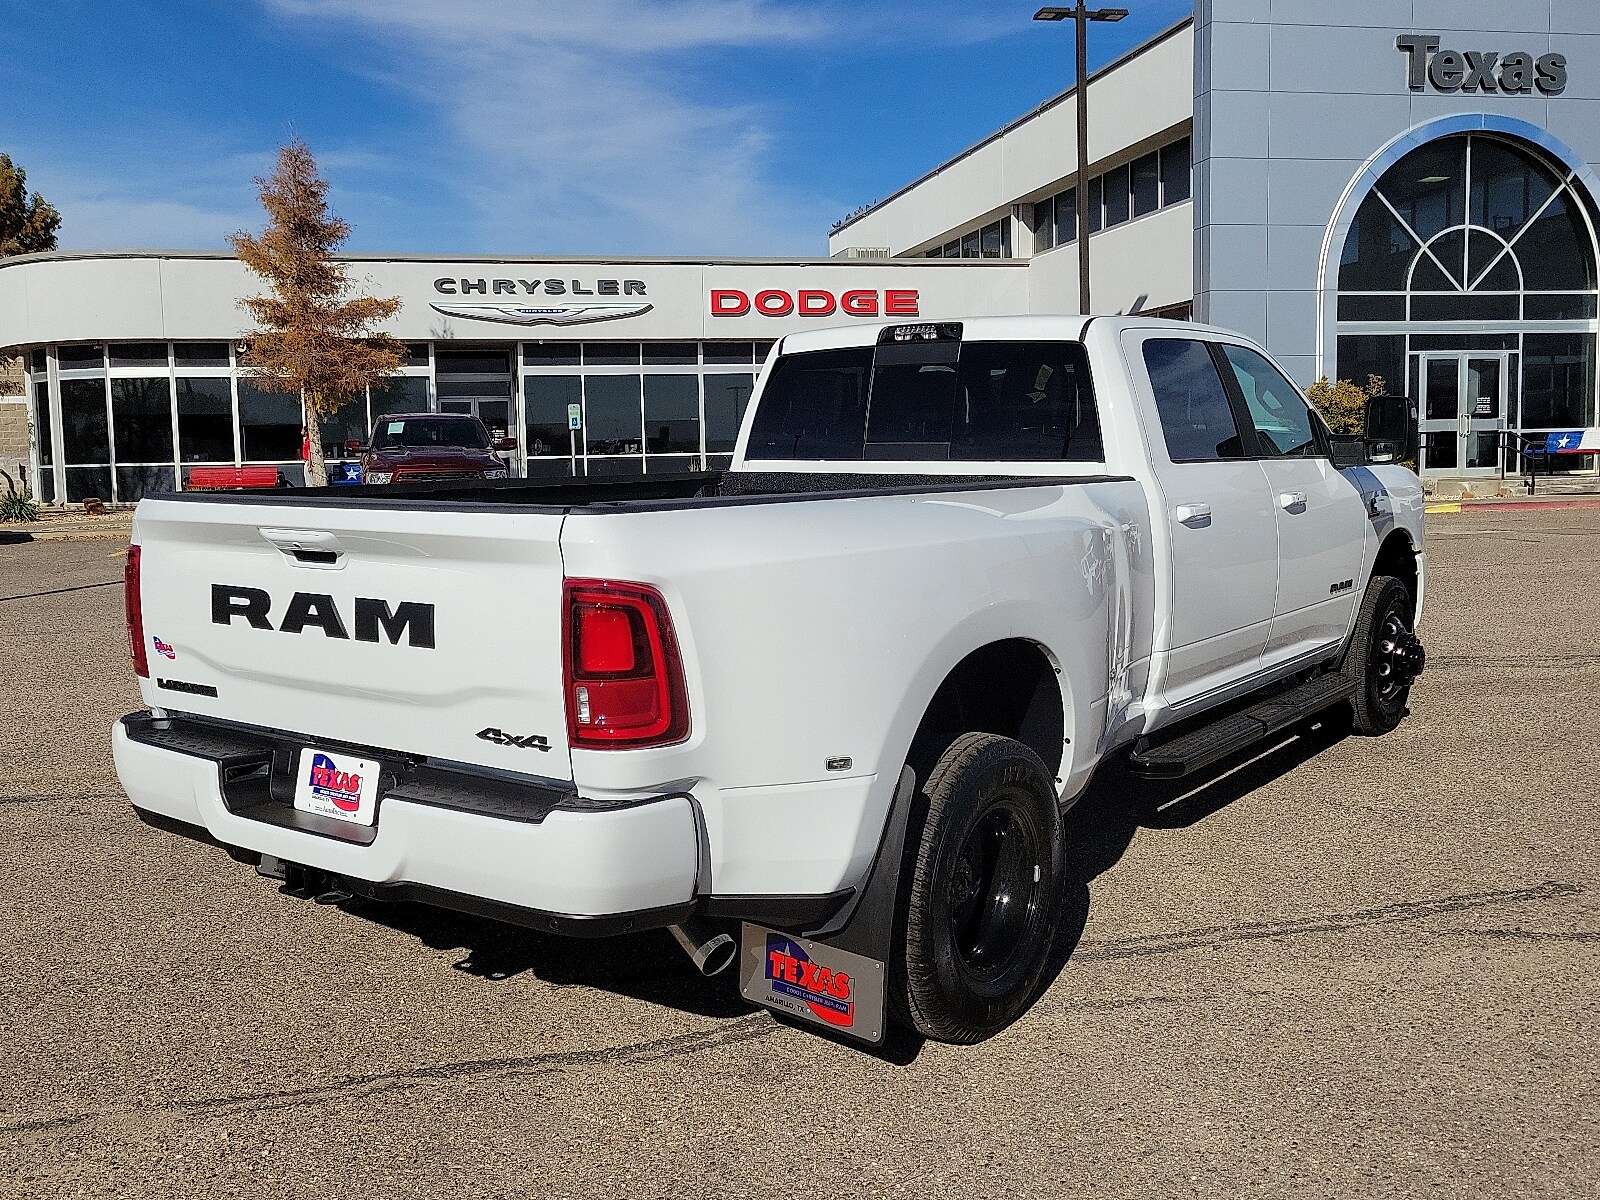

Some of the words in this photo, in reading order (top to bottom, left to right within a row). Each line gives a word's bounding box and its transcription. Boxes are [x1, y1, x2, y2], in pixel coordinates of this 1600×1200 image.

[1395, 34, 1568, 96] Texas
[433, 277, 648, 296] CHRYSLER
[710, 289, 920, 318] DODGE
[211, 583, 436, 649] RAM
[313, 766, 360, 793] TEXAS
[769, 950, 851, 1000] TEXAS
[796, 1004, 805, 1013] TX
